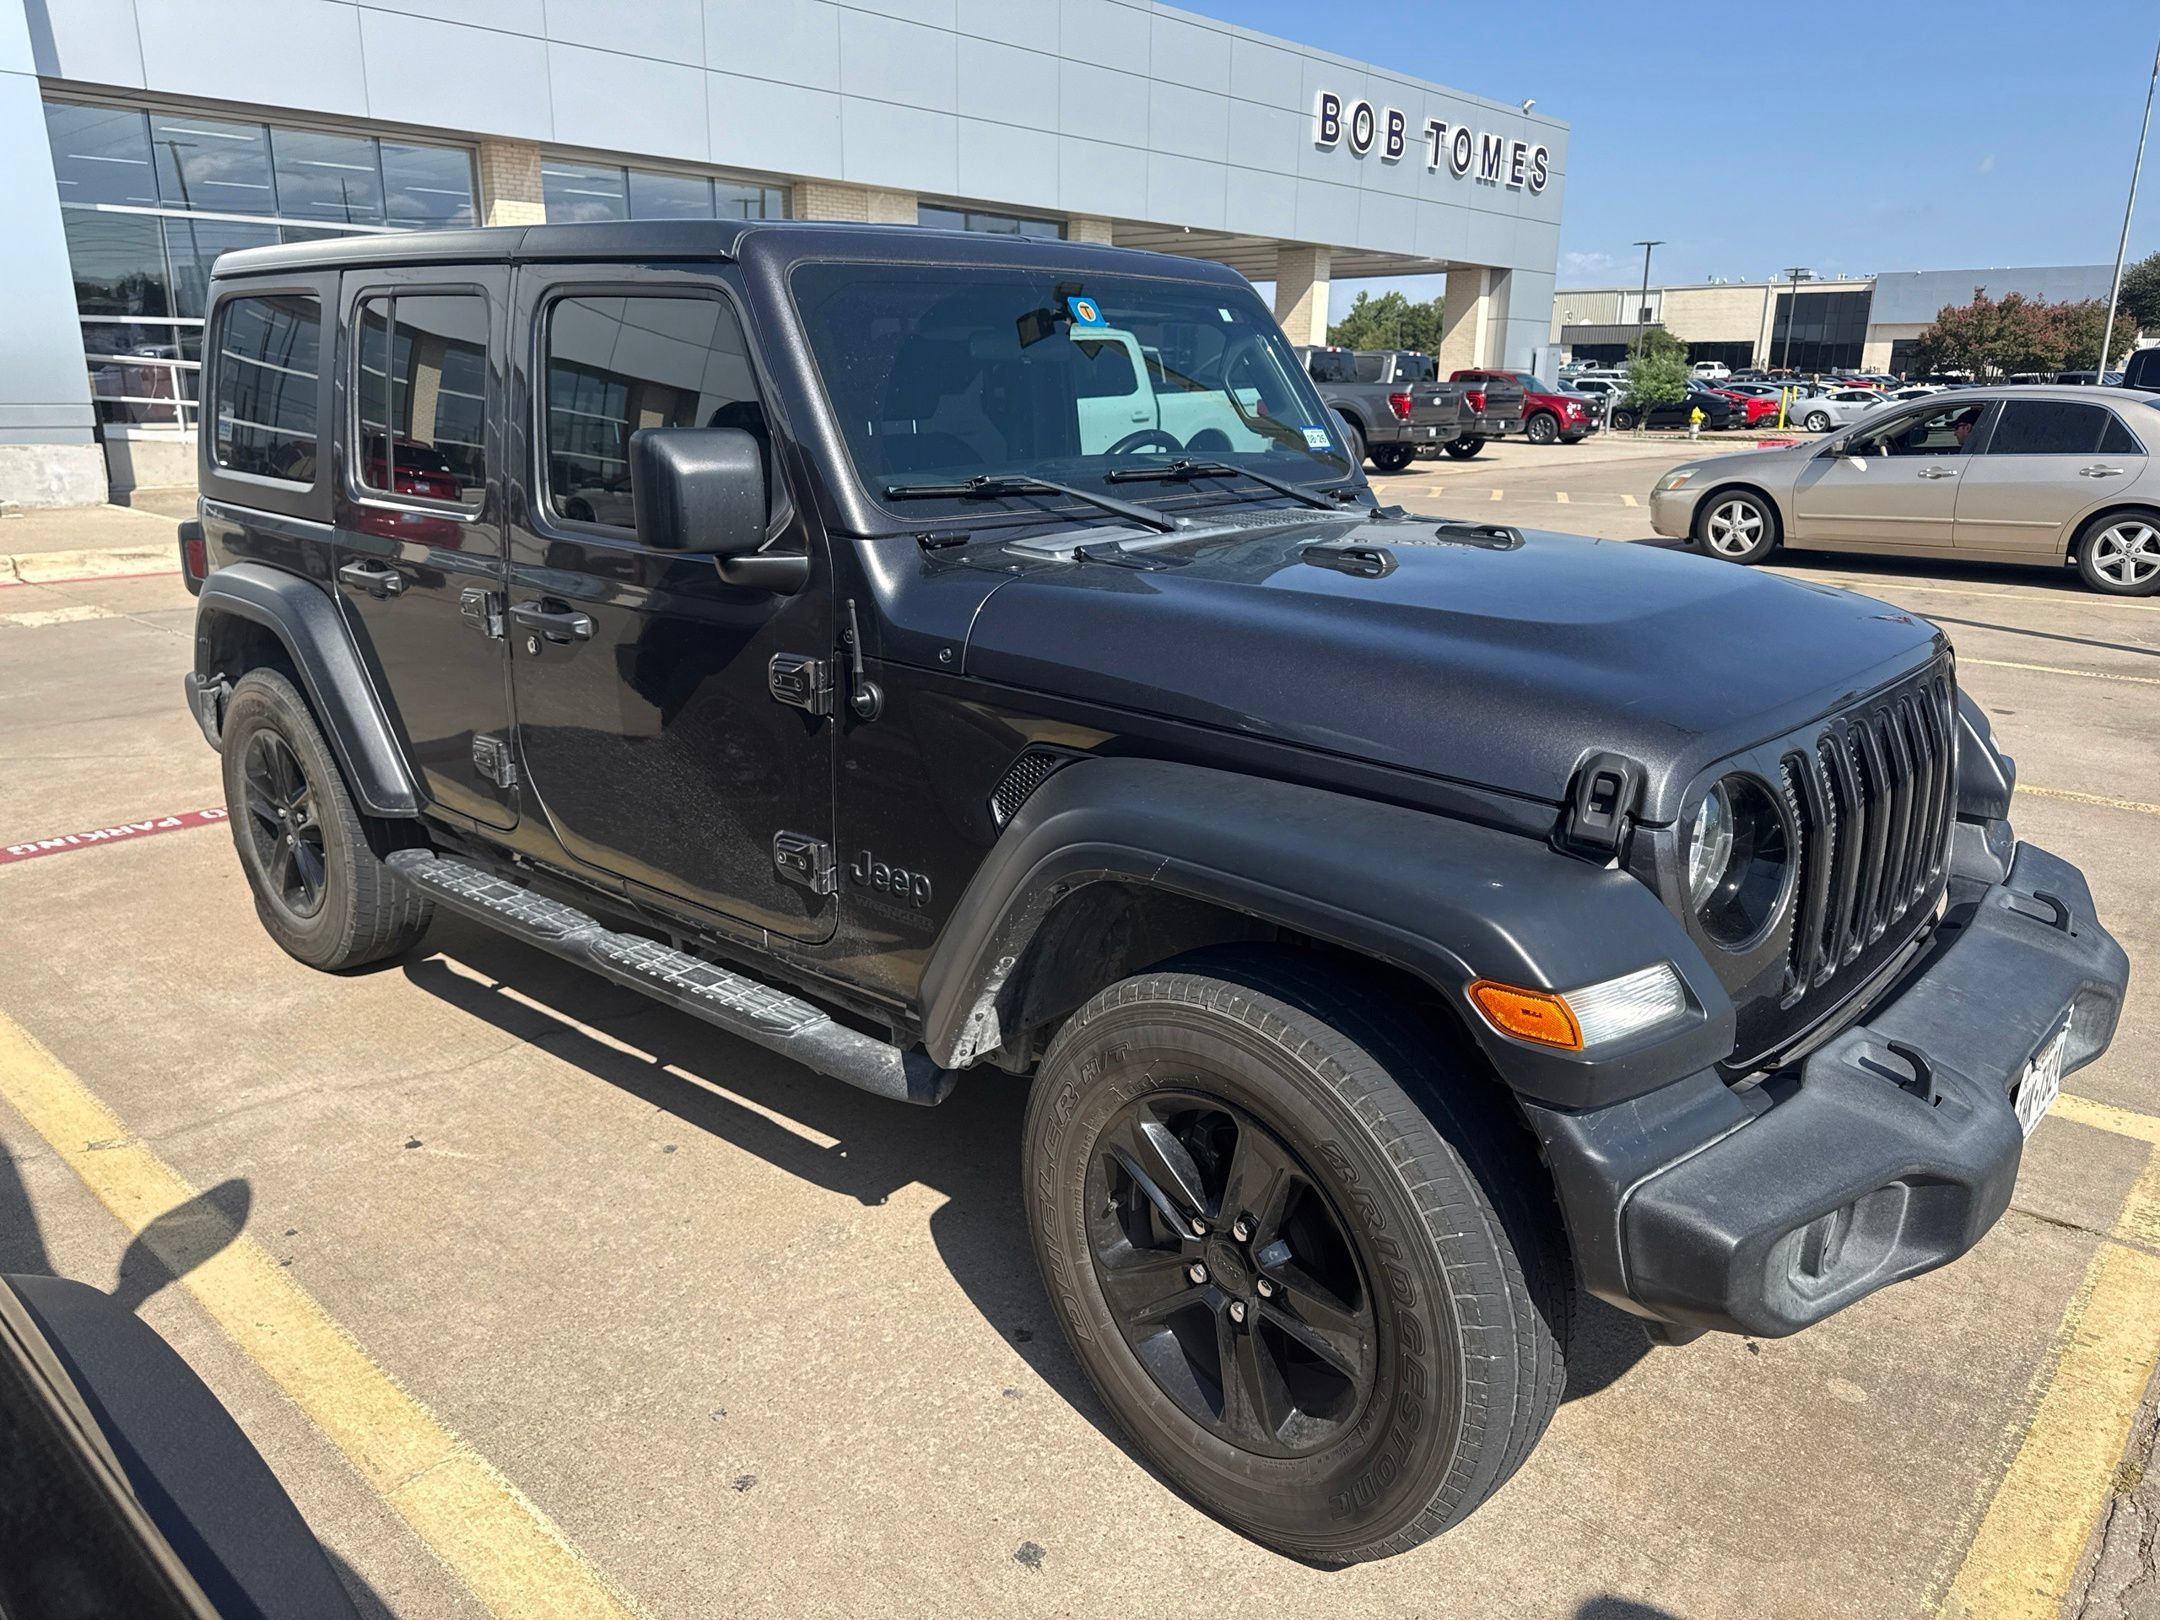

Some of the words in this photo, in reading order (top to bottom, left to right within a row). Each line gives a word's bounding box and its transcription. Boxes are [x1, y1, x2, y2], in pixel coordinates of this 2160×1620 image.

[1314, 90, 1406, 160] BOB
[1425, 117, 1549, 192] TOMES
[6, 816, 183, 856] PARKING
[850, 849, 932, 909] Jeep
[1039, 1081, 1096, 1343] DUELER
[1080, 1040, 1131, 1087] H/T
[1315, 1139, 1429, 1521] BRIDGESTONE
